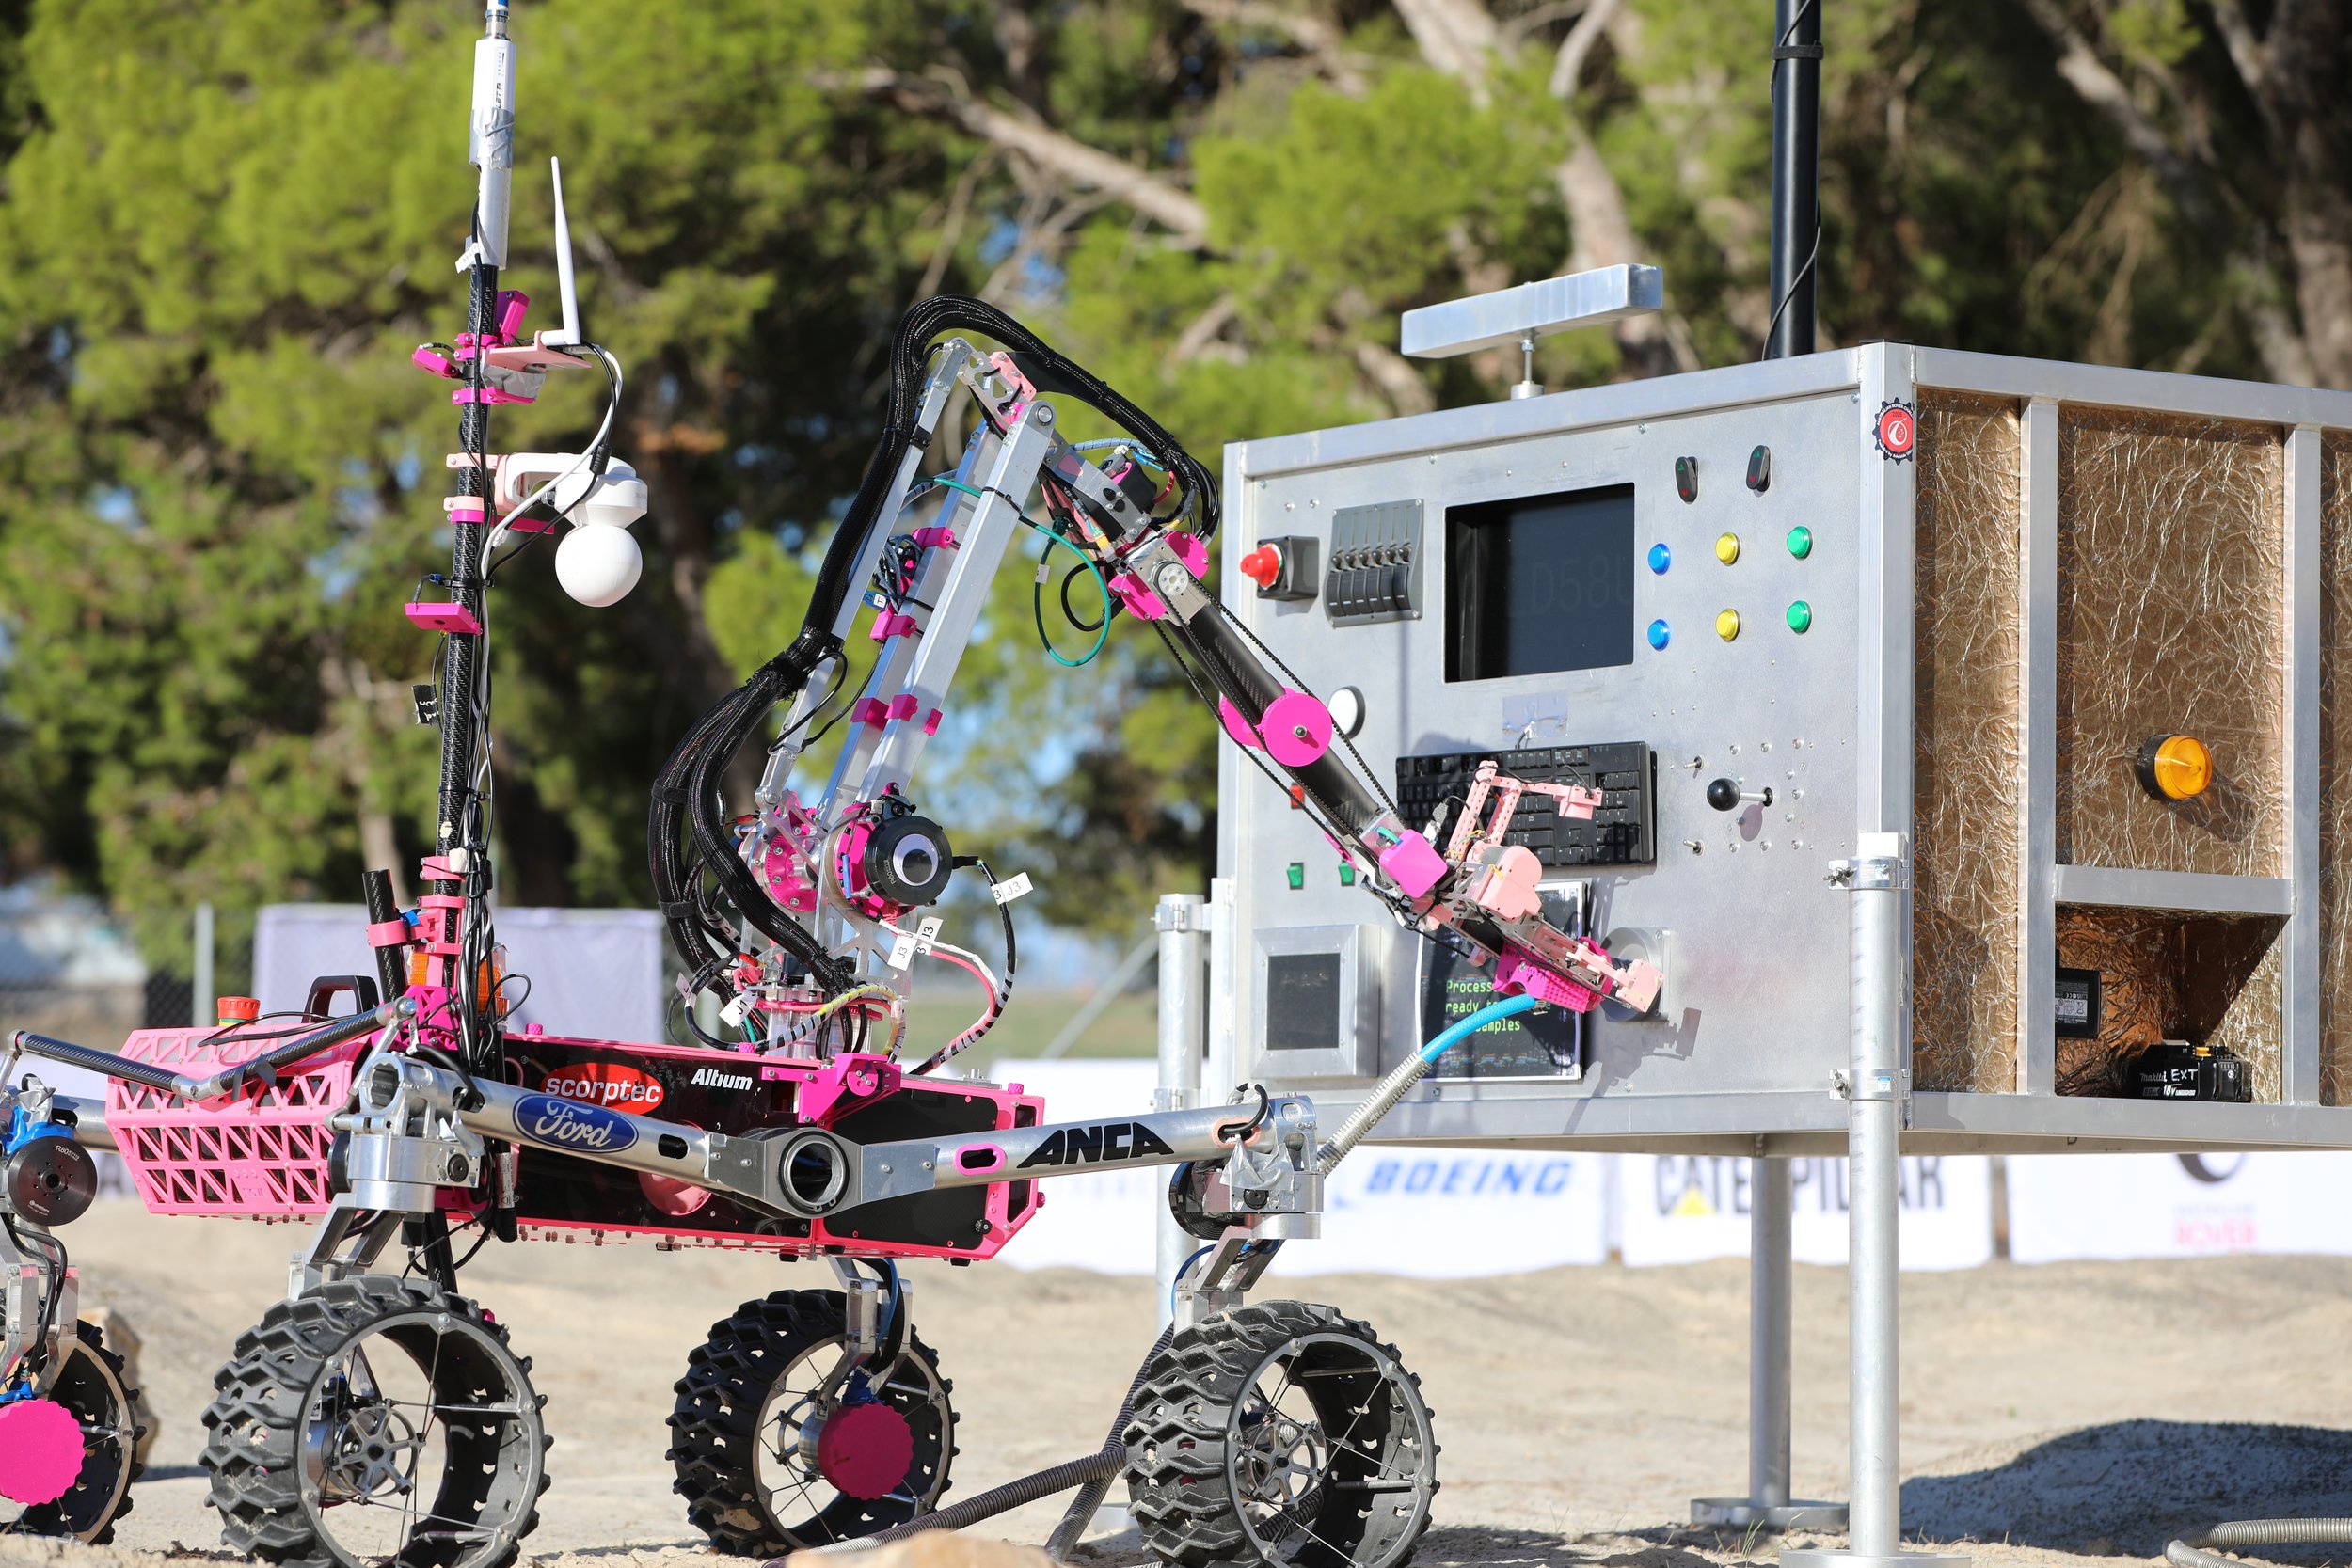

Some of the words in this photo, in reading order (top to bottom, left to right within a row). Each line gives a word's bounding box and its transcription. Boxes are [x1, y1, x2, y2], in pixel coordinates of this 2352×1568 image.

[1007, 881, 1022, 896] J3
[921, 926, 934, 940] J3
[899, 946, 908, 959] J3
[1446, 980, 1497, 993] Process
[1445, 999, 1479, 1014] ready
[1475, 1020, 1520, 1034] samples
[691, 1068, 753, 1091] Altium
[2170, 1069, 2199, 1082] EXT
[546, 1077, 660, 1106] scorptec
[535, 1100, 614, 1148] Ford
[1016, 1122, 1175, 1168] ANCA
[1366, 1159, 1573, 1194] BOEING
[1654, 1154, 1945, 1215] CATEPILR
